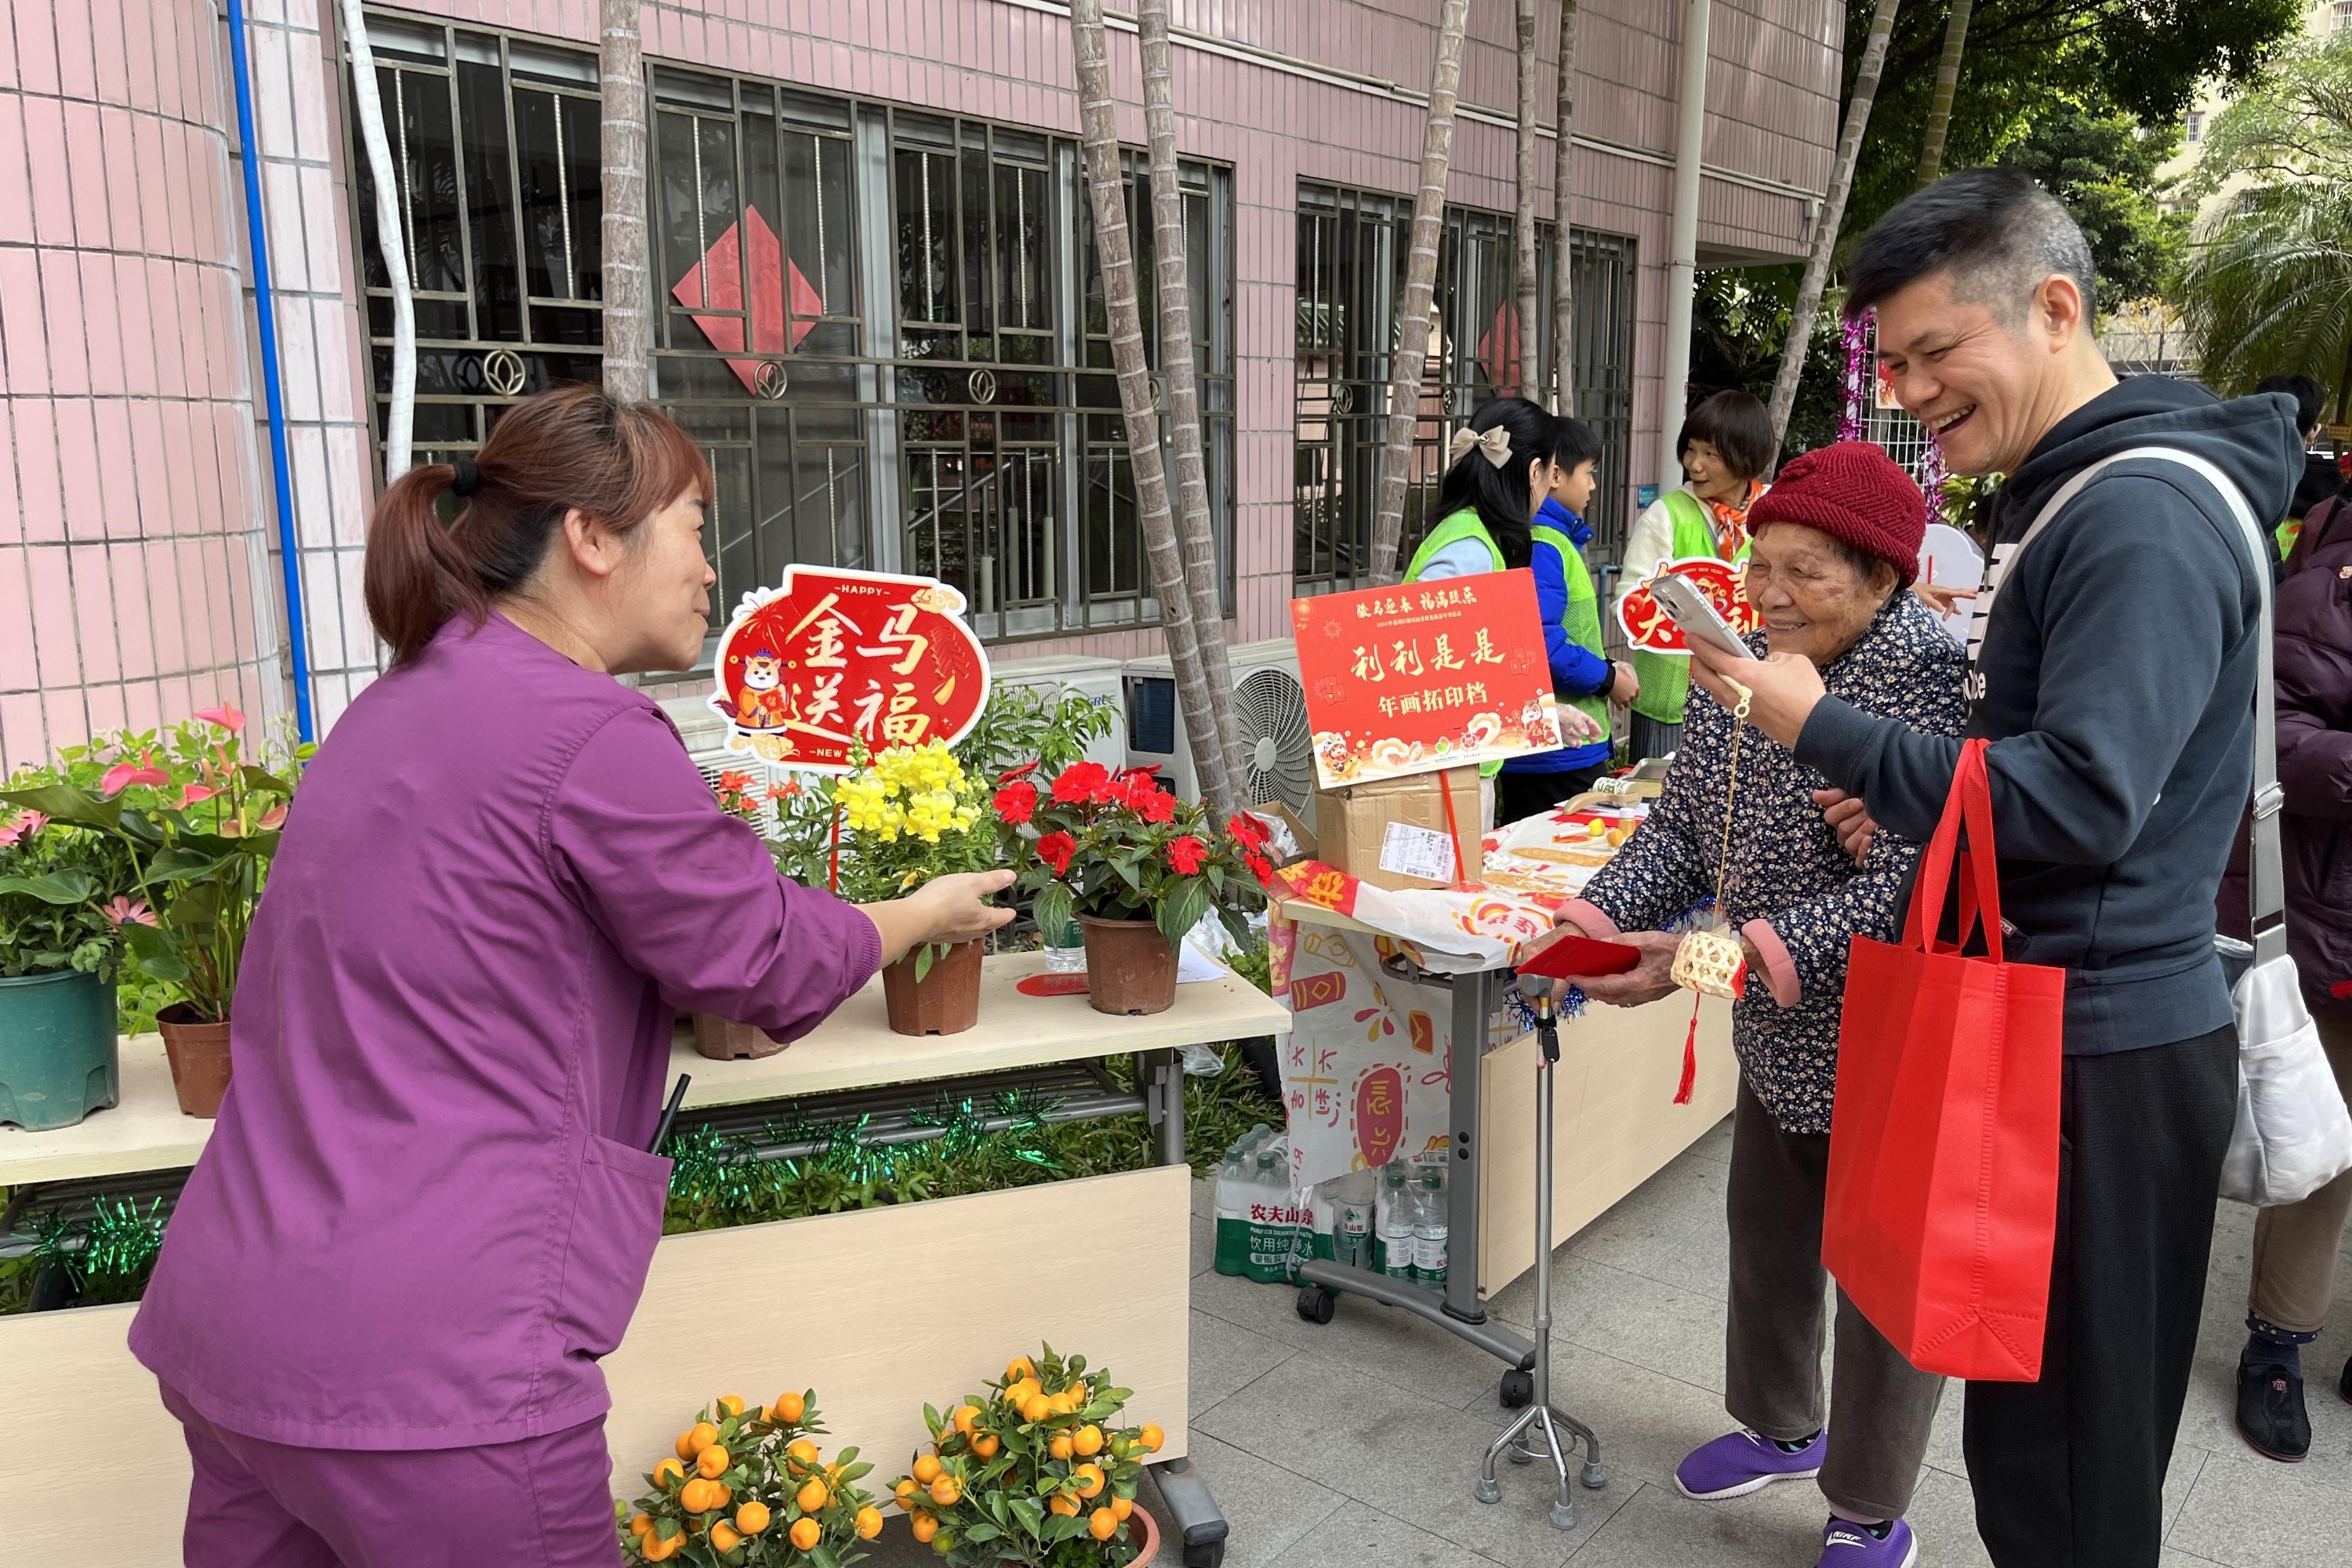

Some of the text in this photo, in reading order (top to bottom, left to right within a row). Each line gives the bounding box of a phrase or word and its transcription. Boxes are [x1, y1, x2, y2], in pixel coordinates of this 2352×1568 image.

[785, 592, 929, 676] 金马
[1351, 627, 1505, 682] 利利是是
[784, 672, 931, 746] 送福
[1378, 681, 1488, 718] 年画拓印档
[1250, 1203, 1313, 1225] 农夫山泉
[1250, 1226, 1273, 1236] PURIFIED
